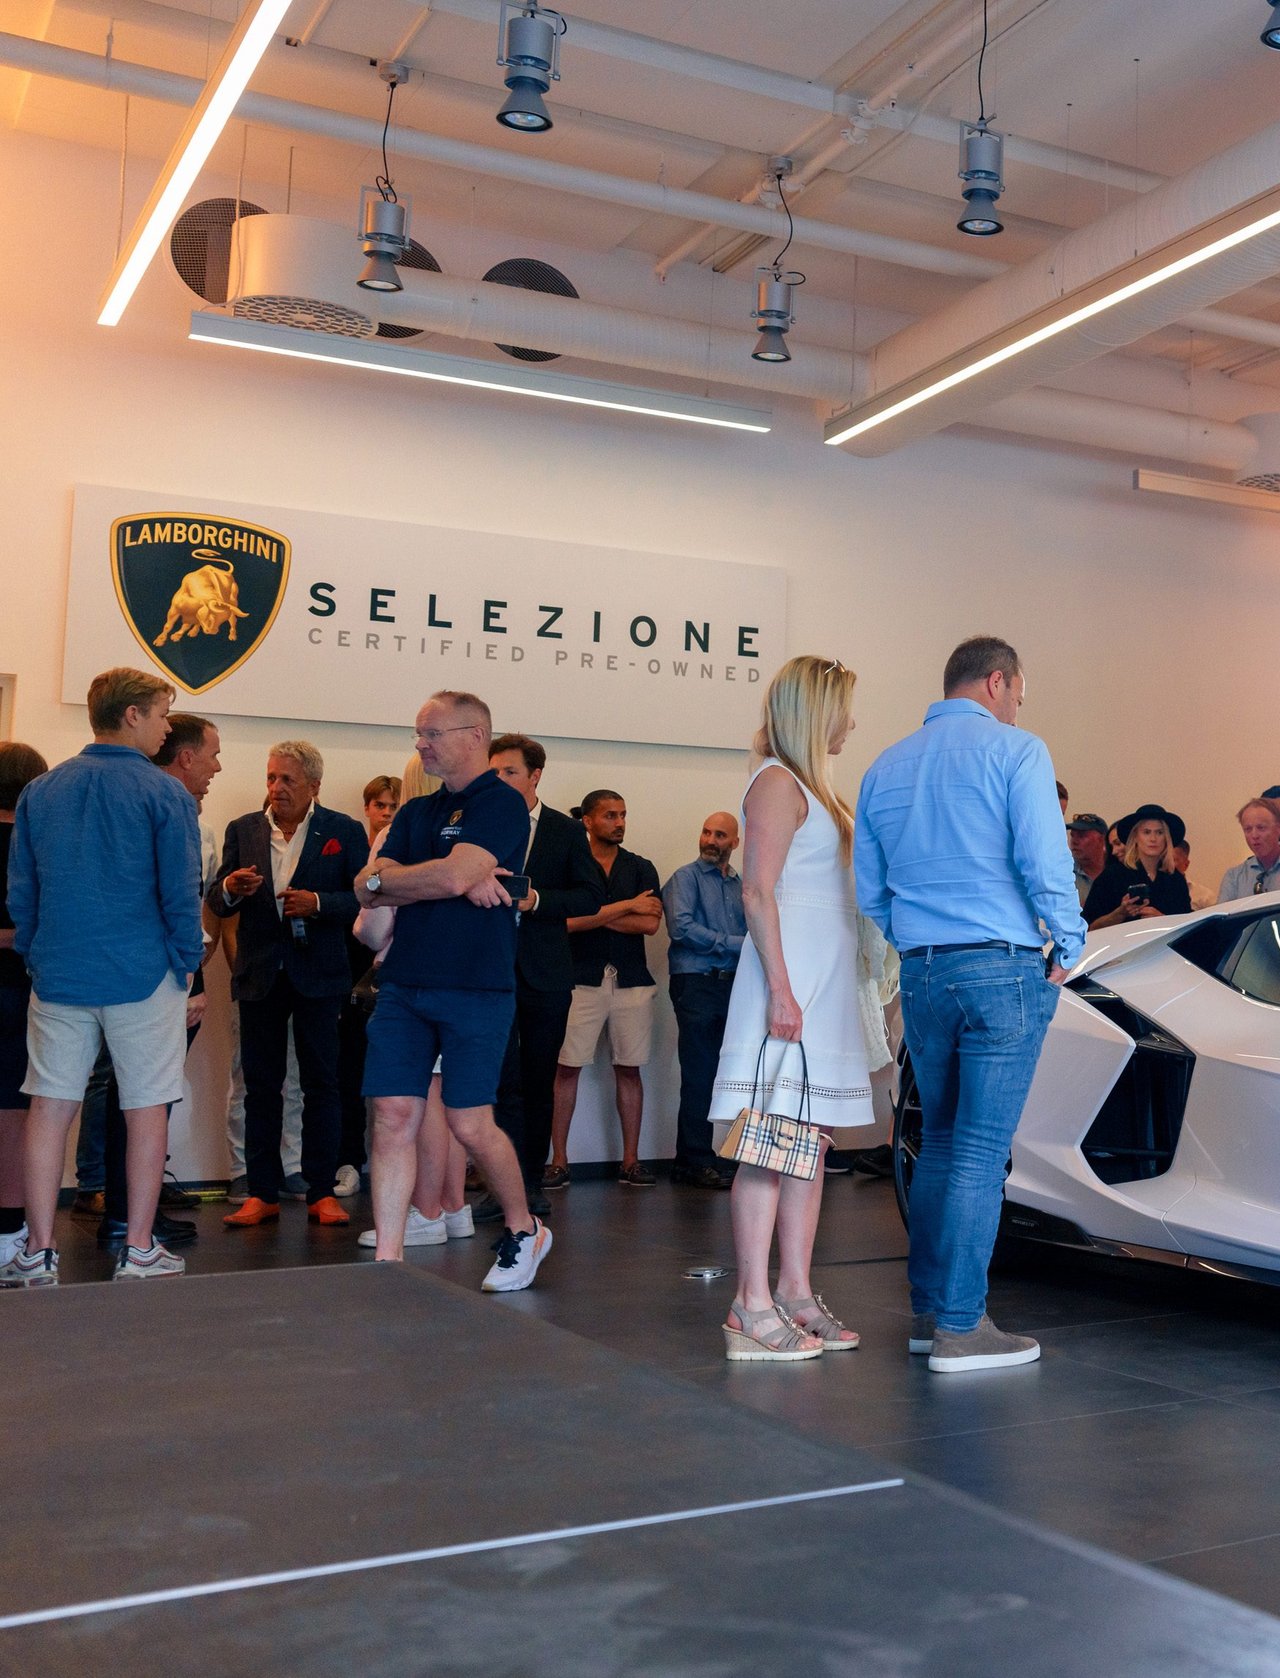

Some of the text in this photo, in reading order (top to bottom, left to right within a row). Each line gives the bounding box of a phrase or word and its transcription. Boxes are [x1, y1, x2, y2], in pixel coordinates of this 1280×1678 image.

[125, 522, 278, 563] LAMBORGHINI
[307, 582, 759, 657] SELEZIONE
[308, 628, 760, 683] CERTIFIED PRE-OWNED
